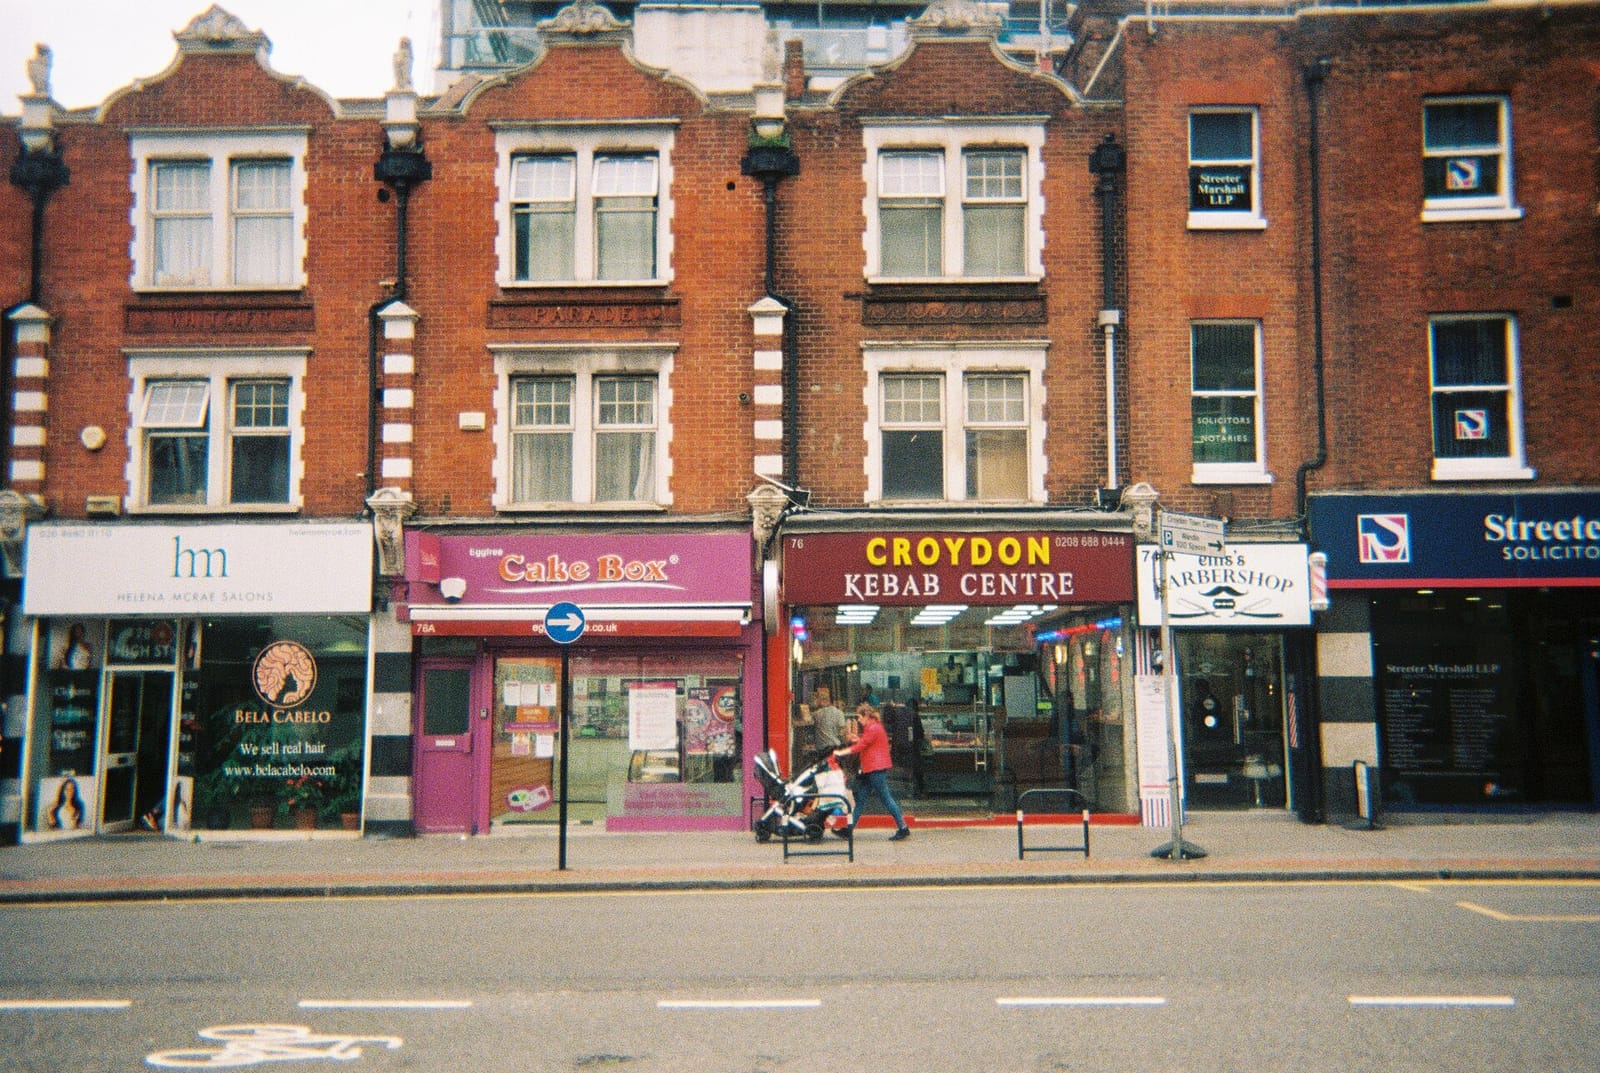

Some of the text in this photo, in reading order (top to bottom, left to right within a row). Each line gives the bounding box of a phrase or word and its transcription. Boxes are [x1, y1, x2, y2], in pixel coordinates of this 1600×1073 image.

[1200, 174, 1240, 183] Streeter
[1198, 184, 1245, 194] Marshall
[1210, 195, 1233, 205] LLP
[534, 306, 634, 323] PARADE
[1197, 416, 1250, 424] SOLICITORS
[1200, 434, 1248, 442] NOTARIES
[791, 538, 804, 549] 76
[1055, 536, 1125, 547] 0208 688 0444
[170, 534, 230, 578] hm
[469, 547, 504, 558] Eggfree
[866, 536, 1049, 566] CROYDON
[499, 554, 590, 582] Cake
[844, 573, 1074, 600] KEBAB CENTRE
[1168, 568, 1294, 593] ARBERSHOP
[117, 592, 273, 602] HELENA MCRAE SALONS
[235, 709, 332, 723] BELA CABELO
[240, 741, 326, 755] We sell real hair
[224, 763, 336, 776] www.belacabelo.com
